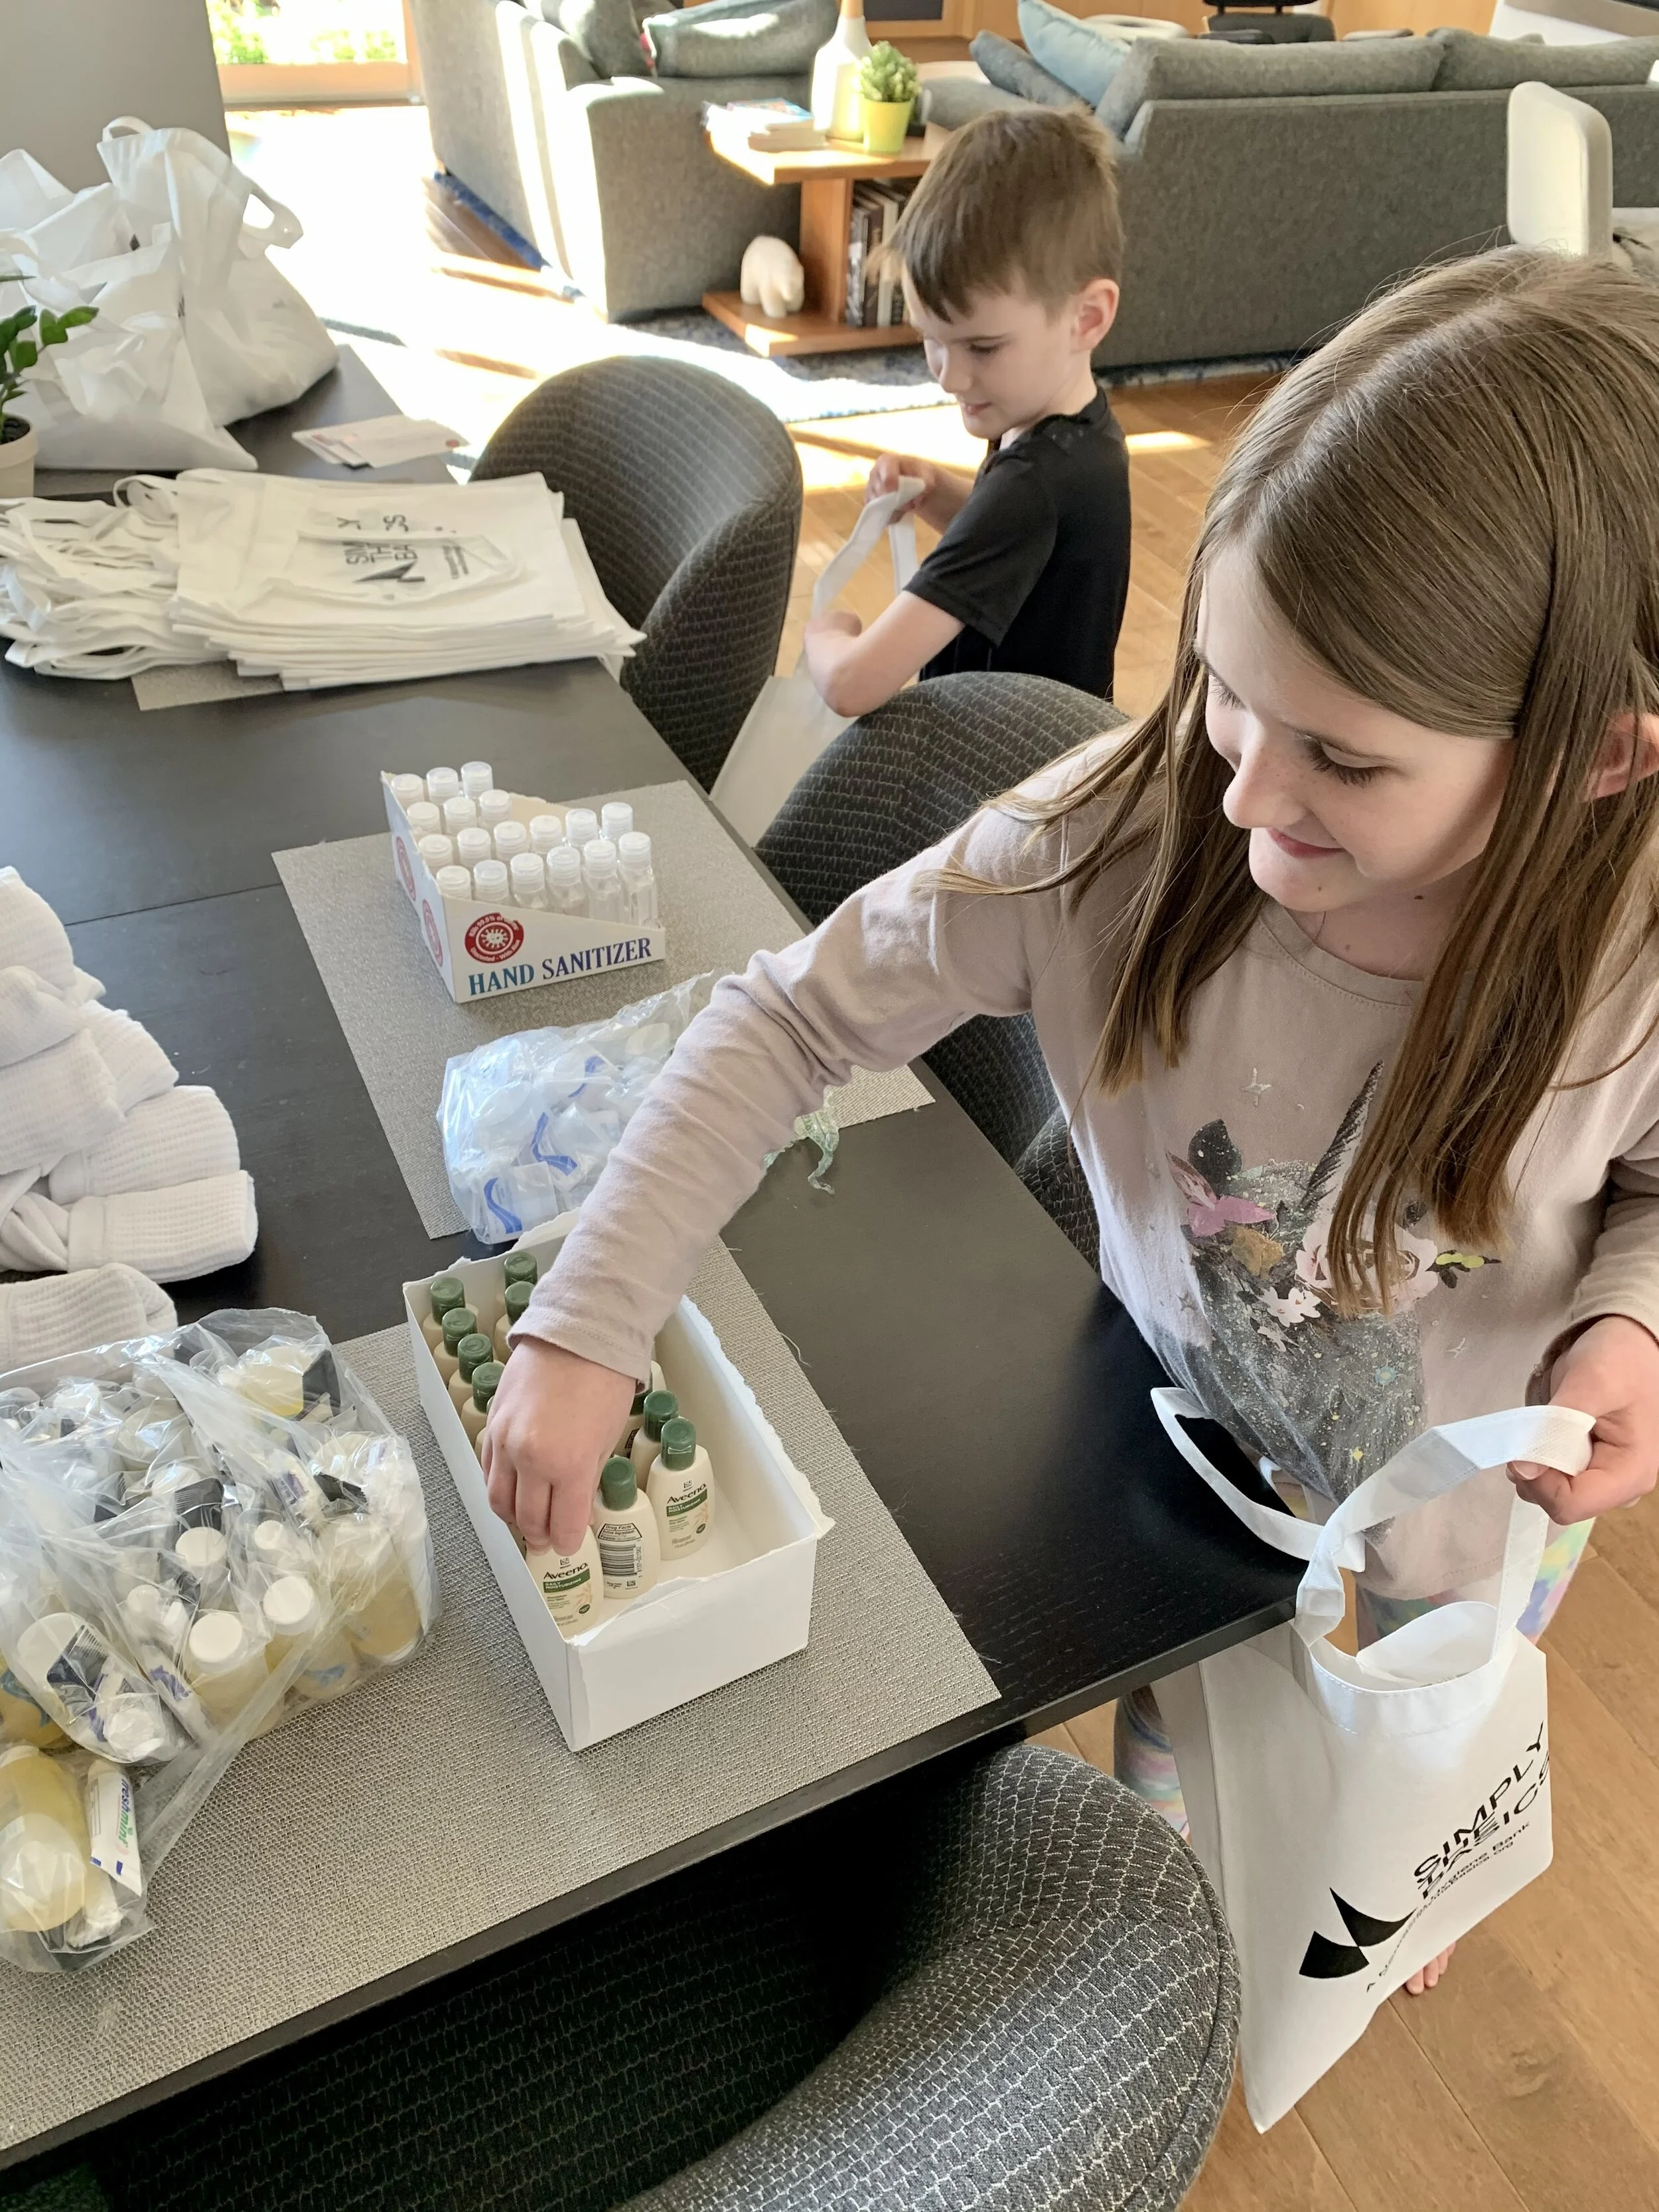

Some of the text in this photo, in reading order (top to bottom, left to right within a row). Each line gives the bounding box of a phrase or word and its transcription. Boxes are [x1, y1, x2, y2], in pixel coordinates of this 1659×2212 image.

[469, 937, 652, 995] HAND SANITIZER
[667, 1483, 706, 1504] Aveeno
[543, 1562, 589, 1580] Aveeno
[1492, 1820, 1530, 1851] Bank
